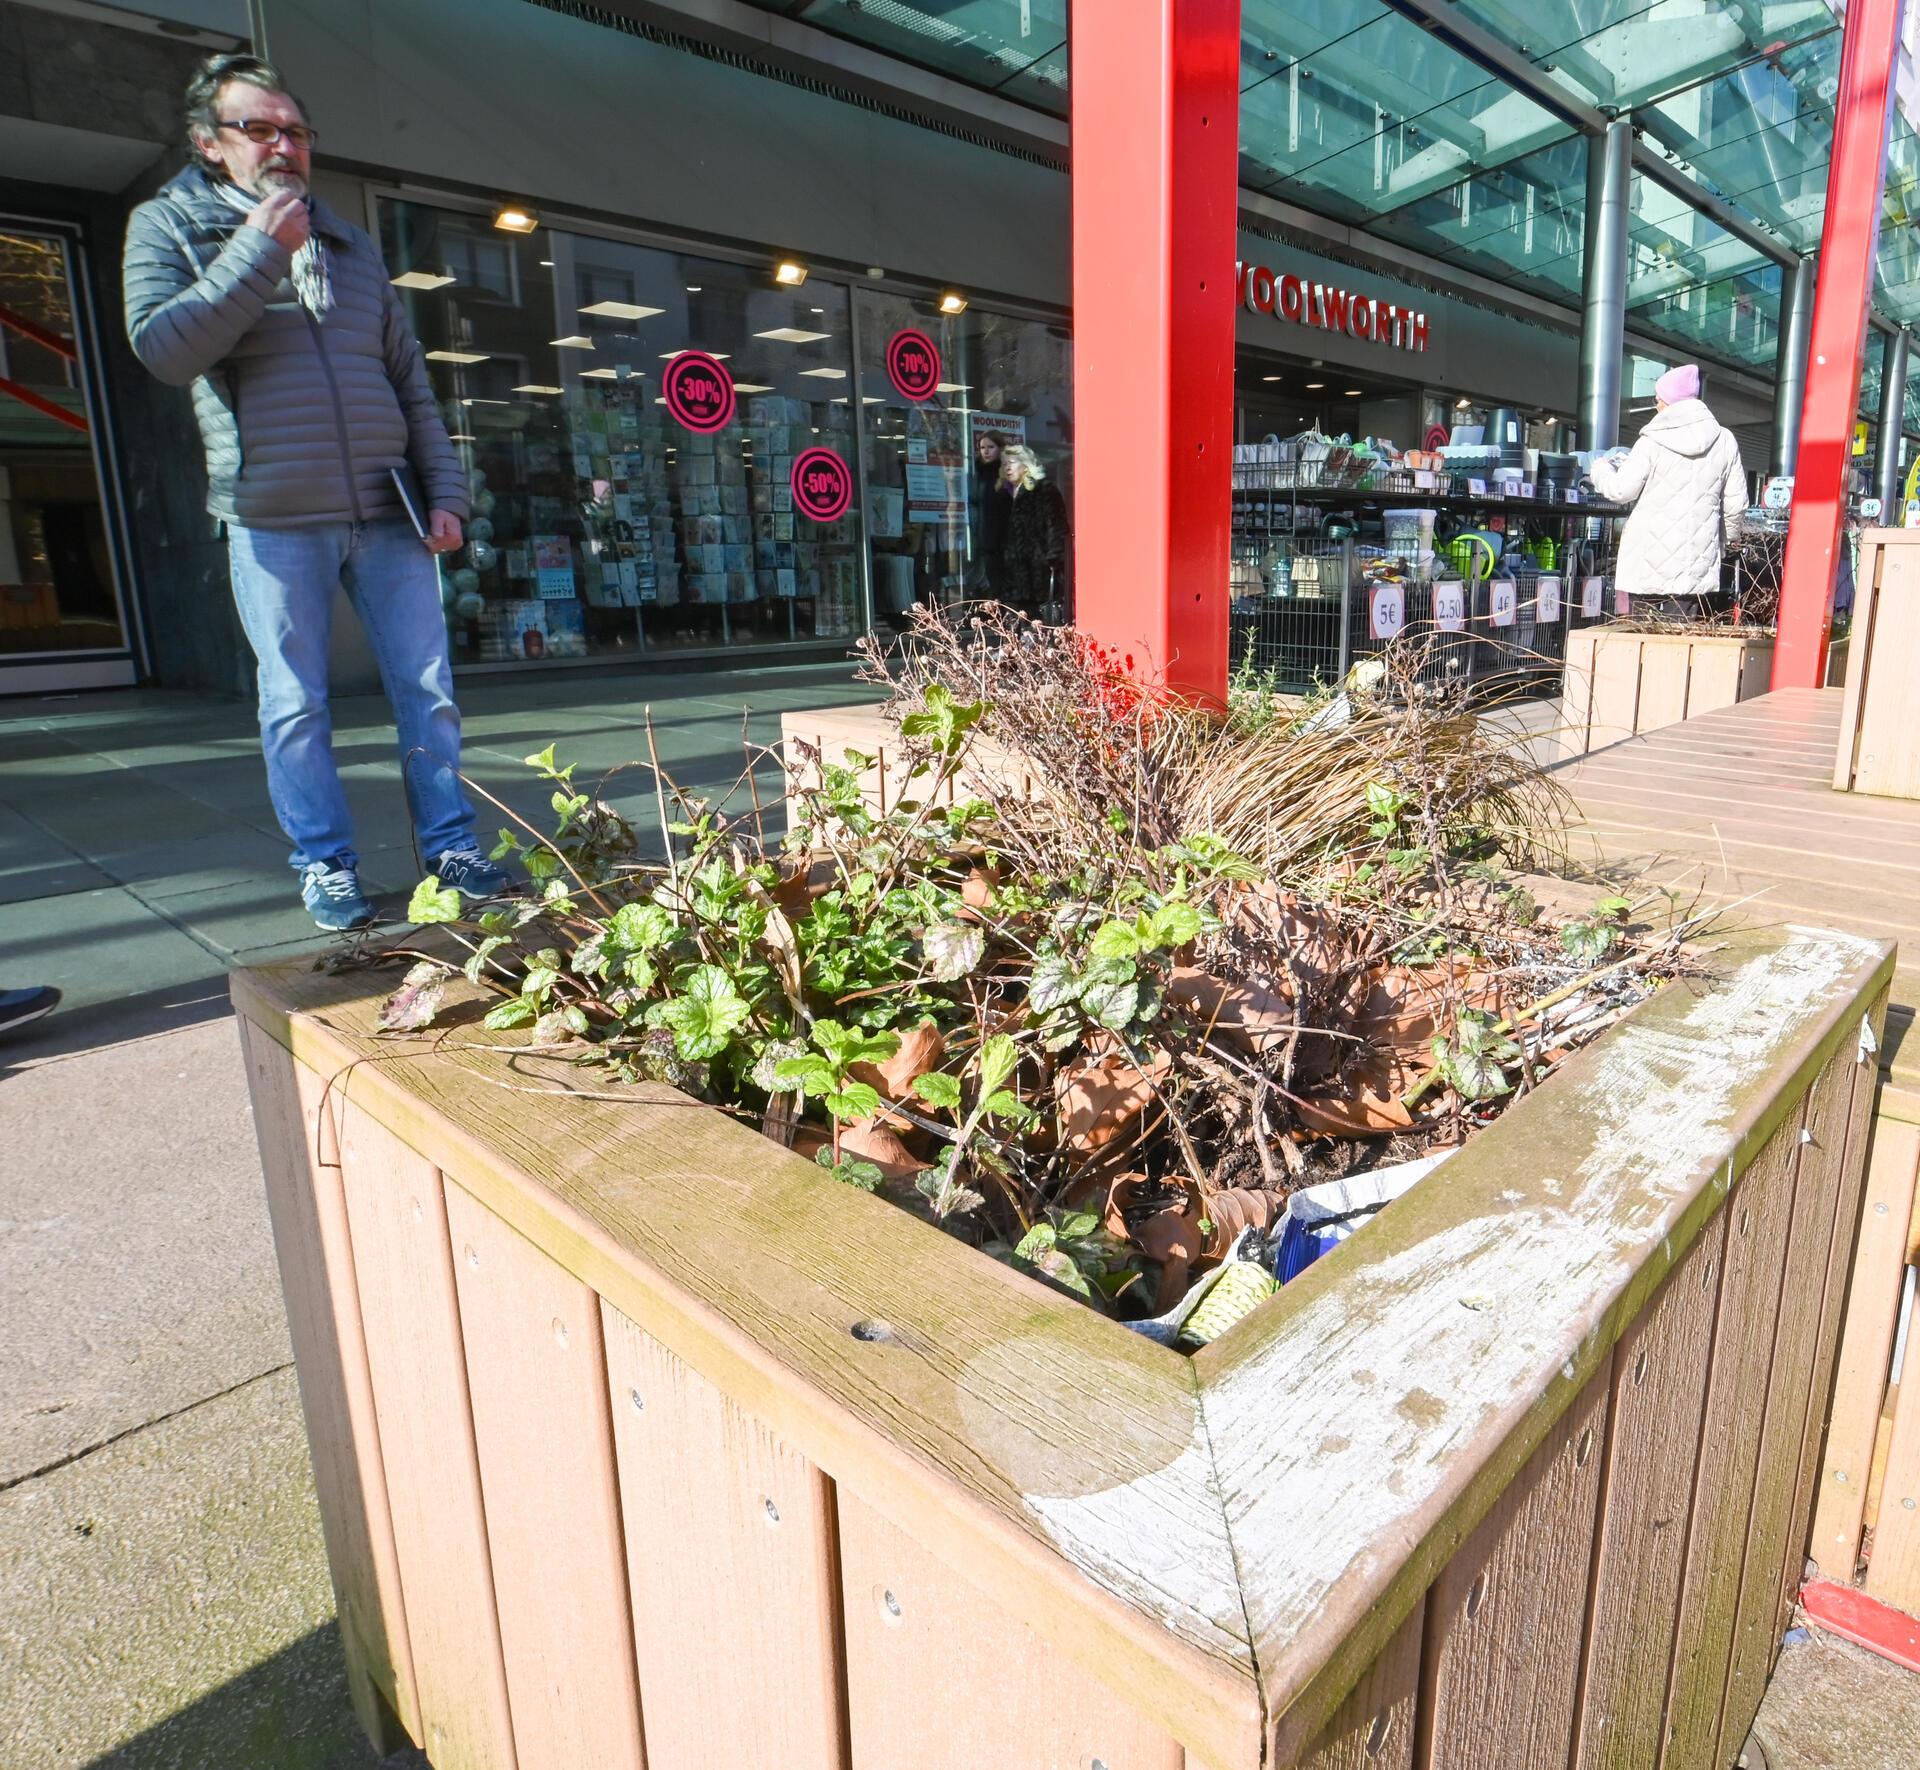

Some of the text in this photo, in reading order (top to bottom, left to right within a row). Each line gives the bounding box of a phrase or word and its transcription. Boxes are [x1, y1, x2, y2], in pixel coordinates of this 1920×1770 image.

[678, 377, 720, 404] -30%
[973, 416, 1021, 430] WOOLWORTH
[804, 472, 840, 493] -50%
[1380, 603, 1396, 625] 5€
[1438, 599, 1461, 619] 2.50
[1497, 595, 1511, 614] 4€
